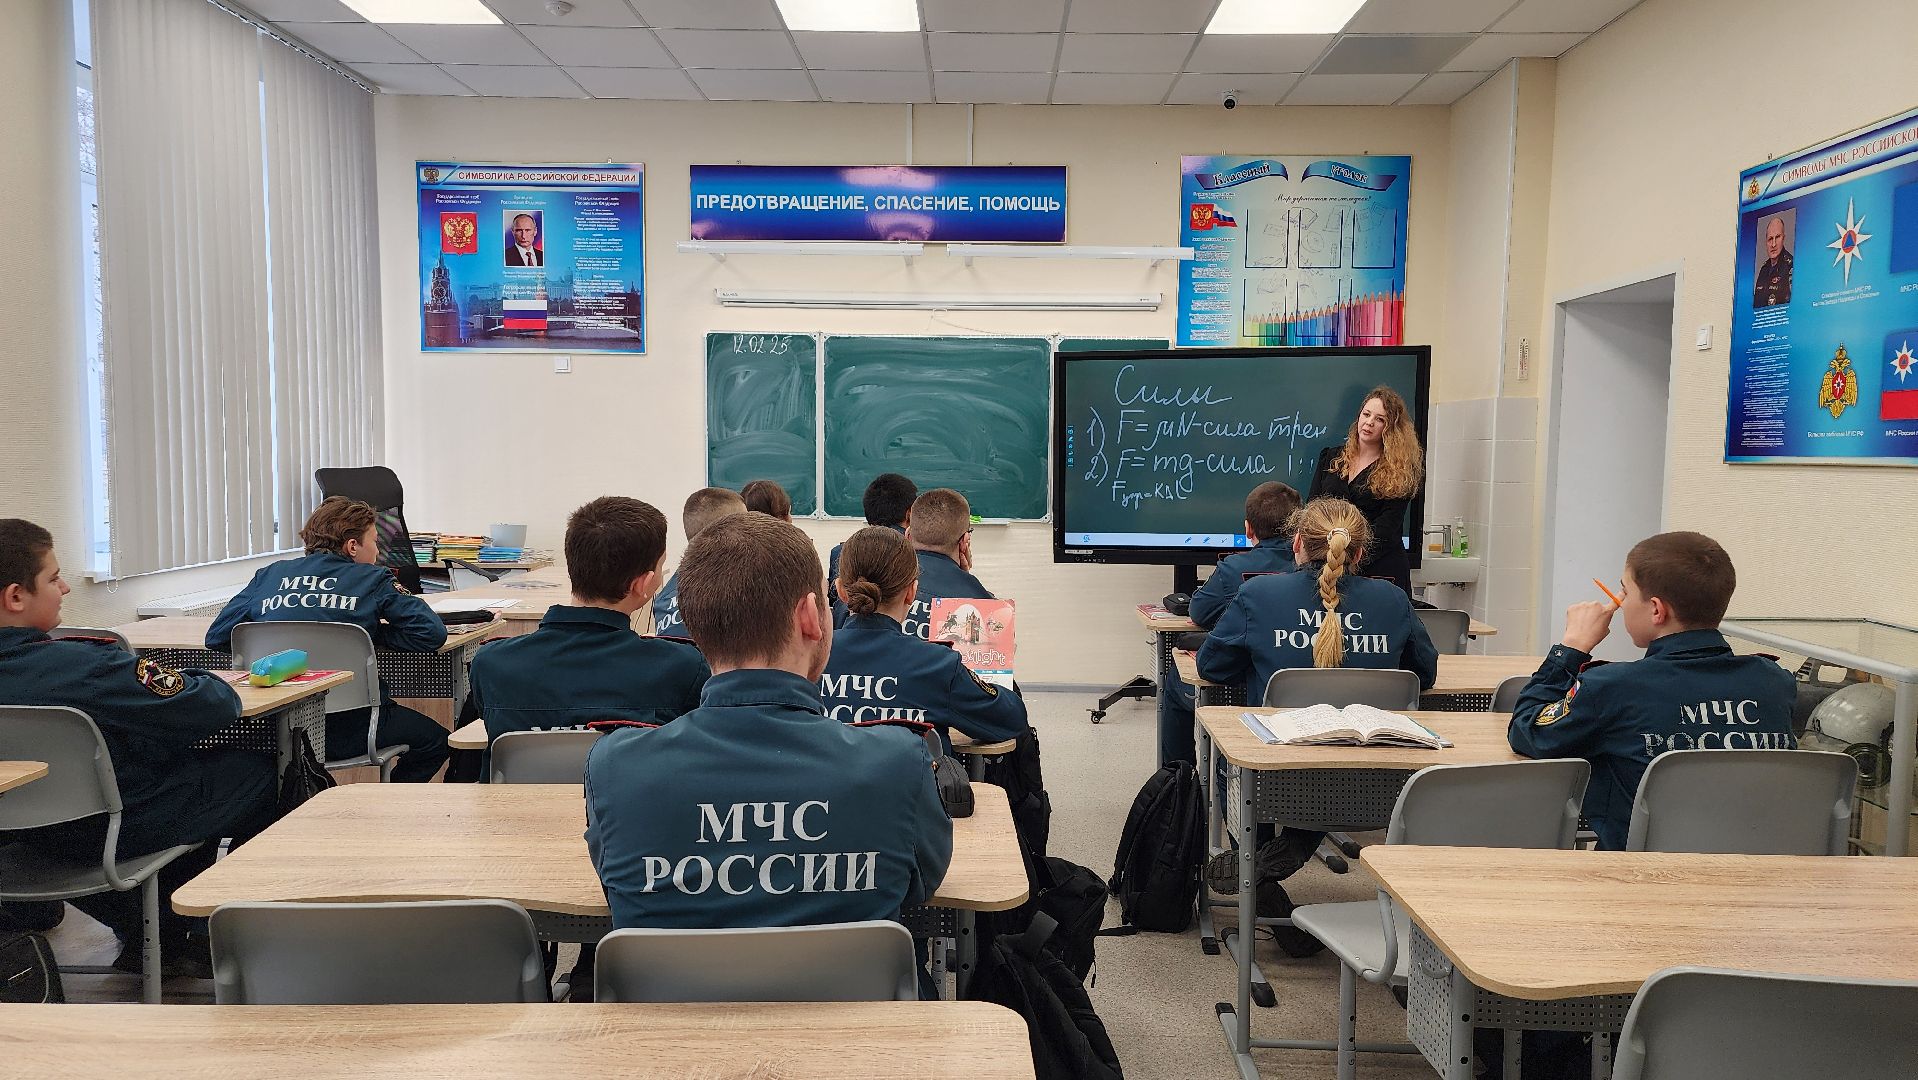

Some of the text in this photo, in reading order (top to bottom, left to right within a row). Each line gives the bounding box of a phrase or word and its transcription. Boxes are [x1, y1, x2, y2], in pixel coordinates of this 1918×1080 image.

[458, 171, 636, 182] СИМВОЛИКА РОССИЙСКОЙ ФЕДЕРАЦИИ
[1213, 162, 1271, 187] Классный
[1782, 158, 1827, 184] СИМВОЛЫ
[1828, 150, 1850, 170] МЧС
[696, 194, 1061, 213] ПРЕДОТВРАЩЕНИЕ, СПАСЕНИЕ, ПОМОЩЬ
[1114, 364, 1233, 407] Силы
[278, 575, 338, 591] МЧС
[261, 592, 359, 616] РОССИИ
[1298, 608, 1363, 631] МС
[1274, 629, 1390, 654] РОИИ
[960, 649, 1006, 666] otlight
[820, 673, 898, 701] МЧС
[823, 704, 928, 724] ССИИ
[1679, 699, 1760, 725] МЧС
[695, 800, 829, 843] МЧС
[639, 851, 880, 895] РОССИИ
